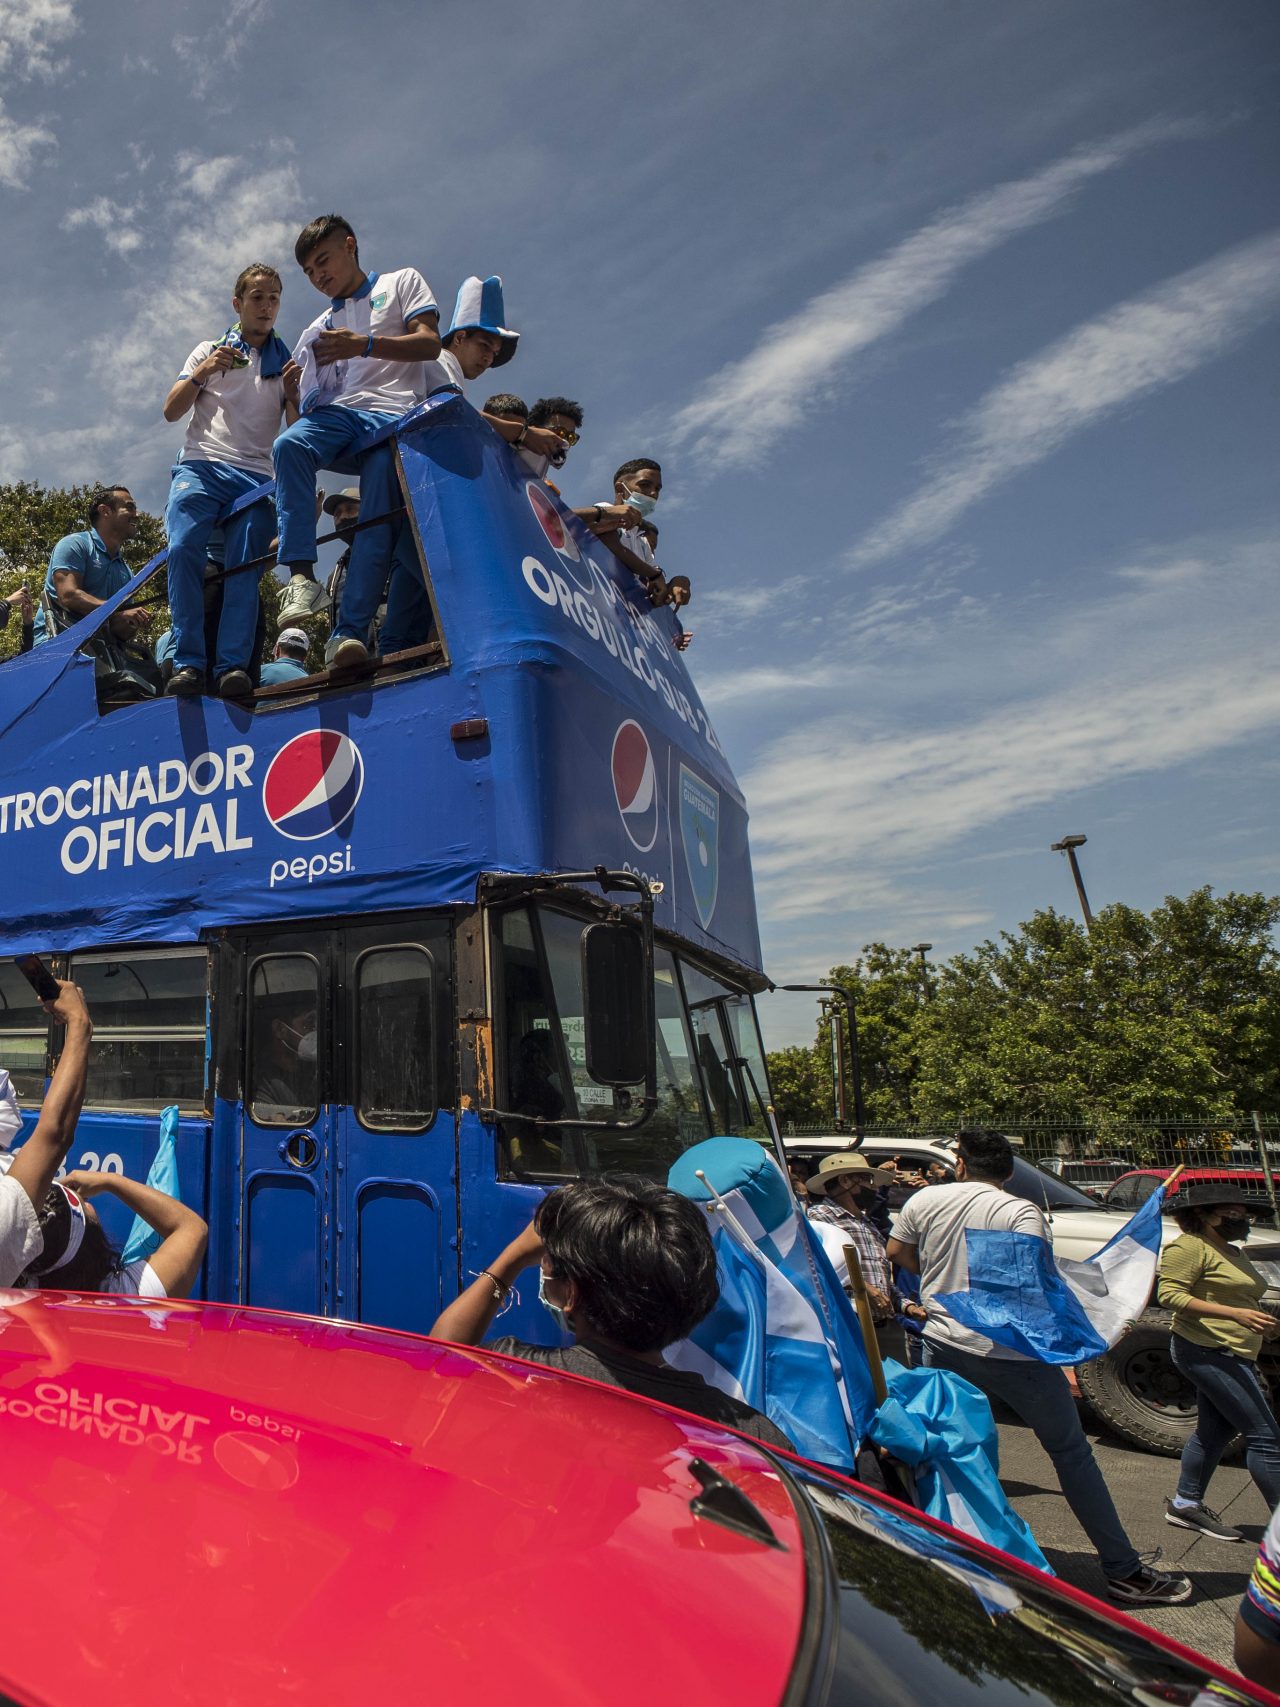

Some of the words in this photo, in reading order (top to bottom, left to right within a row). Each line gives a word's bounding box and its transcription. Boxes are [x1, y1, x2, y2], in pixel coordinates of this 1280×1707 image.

[521, 556, 657, 691] ORGULLO
[655, 668, 700, 734] SUB
[60, 799, 253, 875] OFICIAL
[270, 844, 352, 888] pepsi
